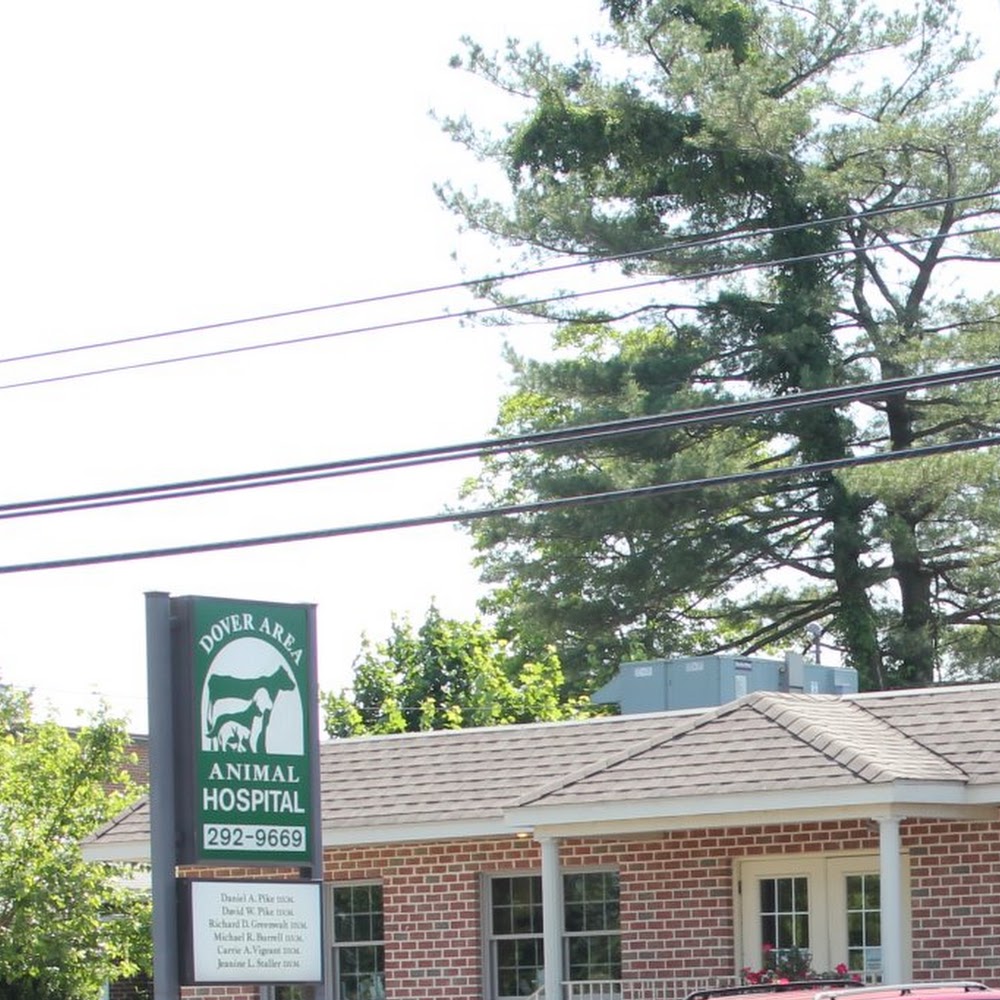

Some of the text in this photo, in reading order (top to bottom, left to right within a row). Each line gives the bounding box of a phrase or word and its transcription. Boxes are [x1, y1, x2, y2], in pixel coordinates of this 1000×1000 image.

[199, 613, 303, 666] DOVER AREA
[208, 762, 300, 783] ANIMAL
[203, 787, 305, 813] HOSPITAL
[207, 827, 303, 848] 292-9669
[220, 893, 246, 903] Daniel
[258, 893, 274, 903] Pike
[222, 906, 243, 916] David
[257, 906, 274, 916] Pike
[208, 919, 240, 928] Richard
[214, 932, 245, 942] Michael
[217, 945, 243, 955] Carrie
